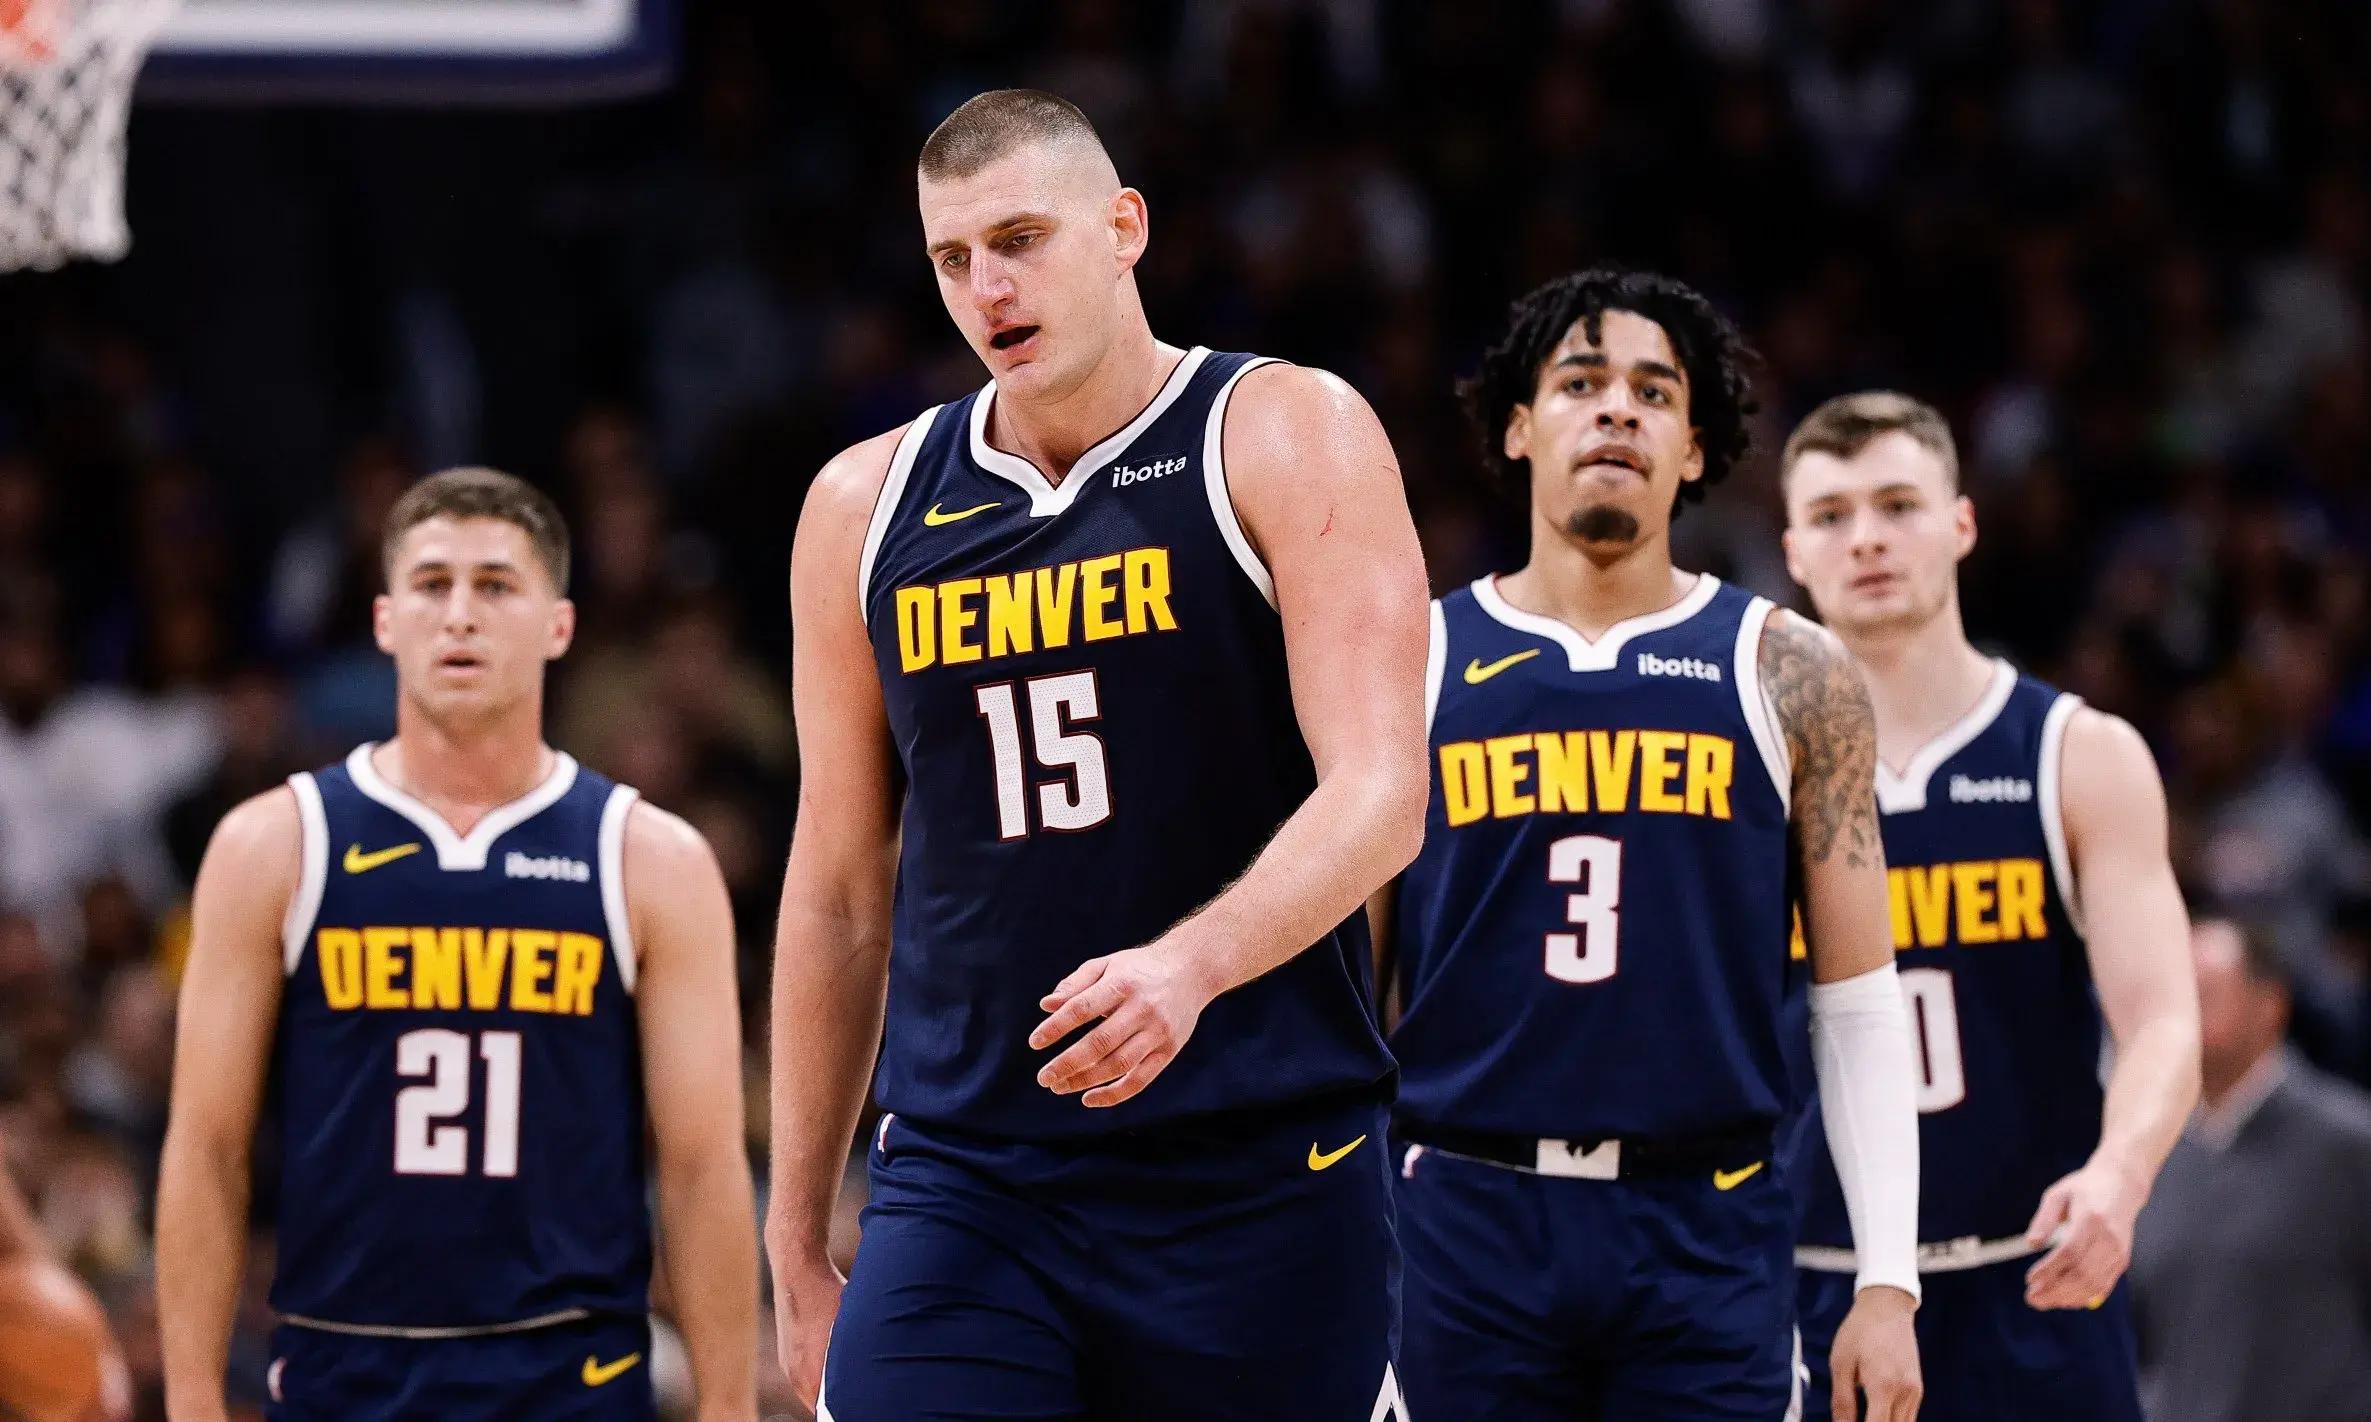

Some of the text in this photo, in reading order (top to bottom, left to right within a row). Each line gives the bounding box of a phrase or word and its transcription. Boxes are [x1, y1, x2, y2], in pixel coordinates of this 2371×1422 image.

[1111, 456, 1187, 488] ibotta
[896, 546, 1180, 675] DENVER
[1638, 653, 1722, 682] ibotta
[974, 668, 1113, 841] 15
[1439, 729, 1734, 828] DENVER
[1544, 834, 1622, 983] 3
[317, 927, 604, 1016] DENVER
[393, 1028, 522, 1178] 21
